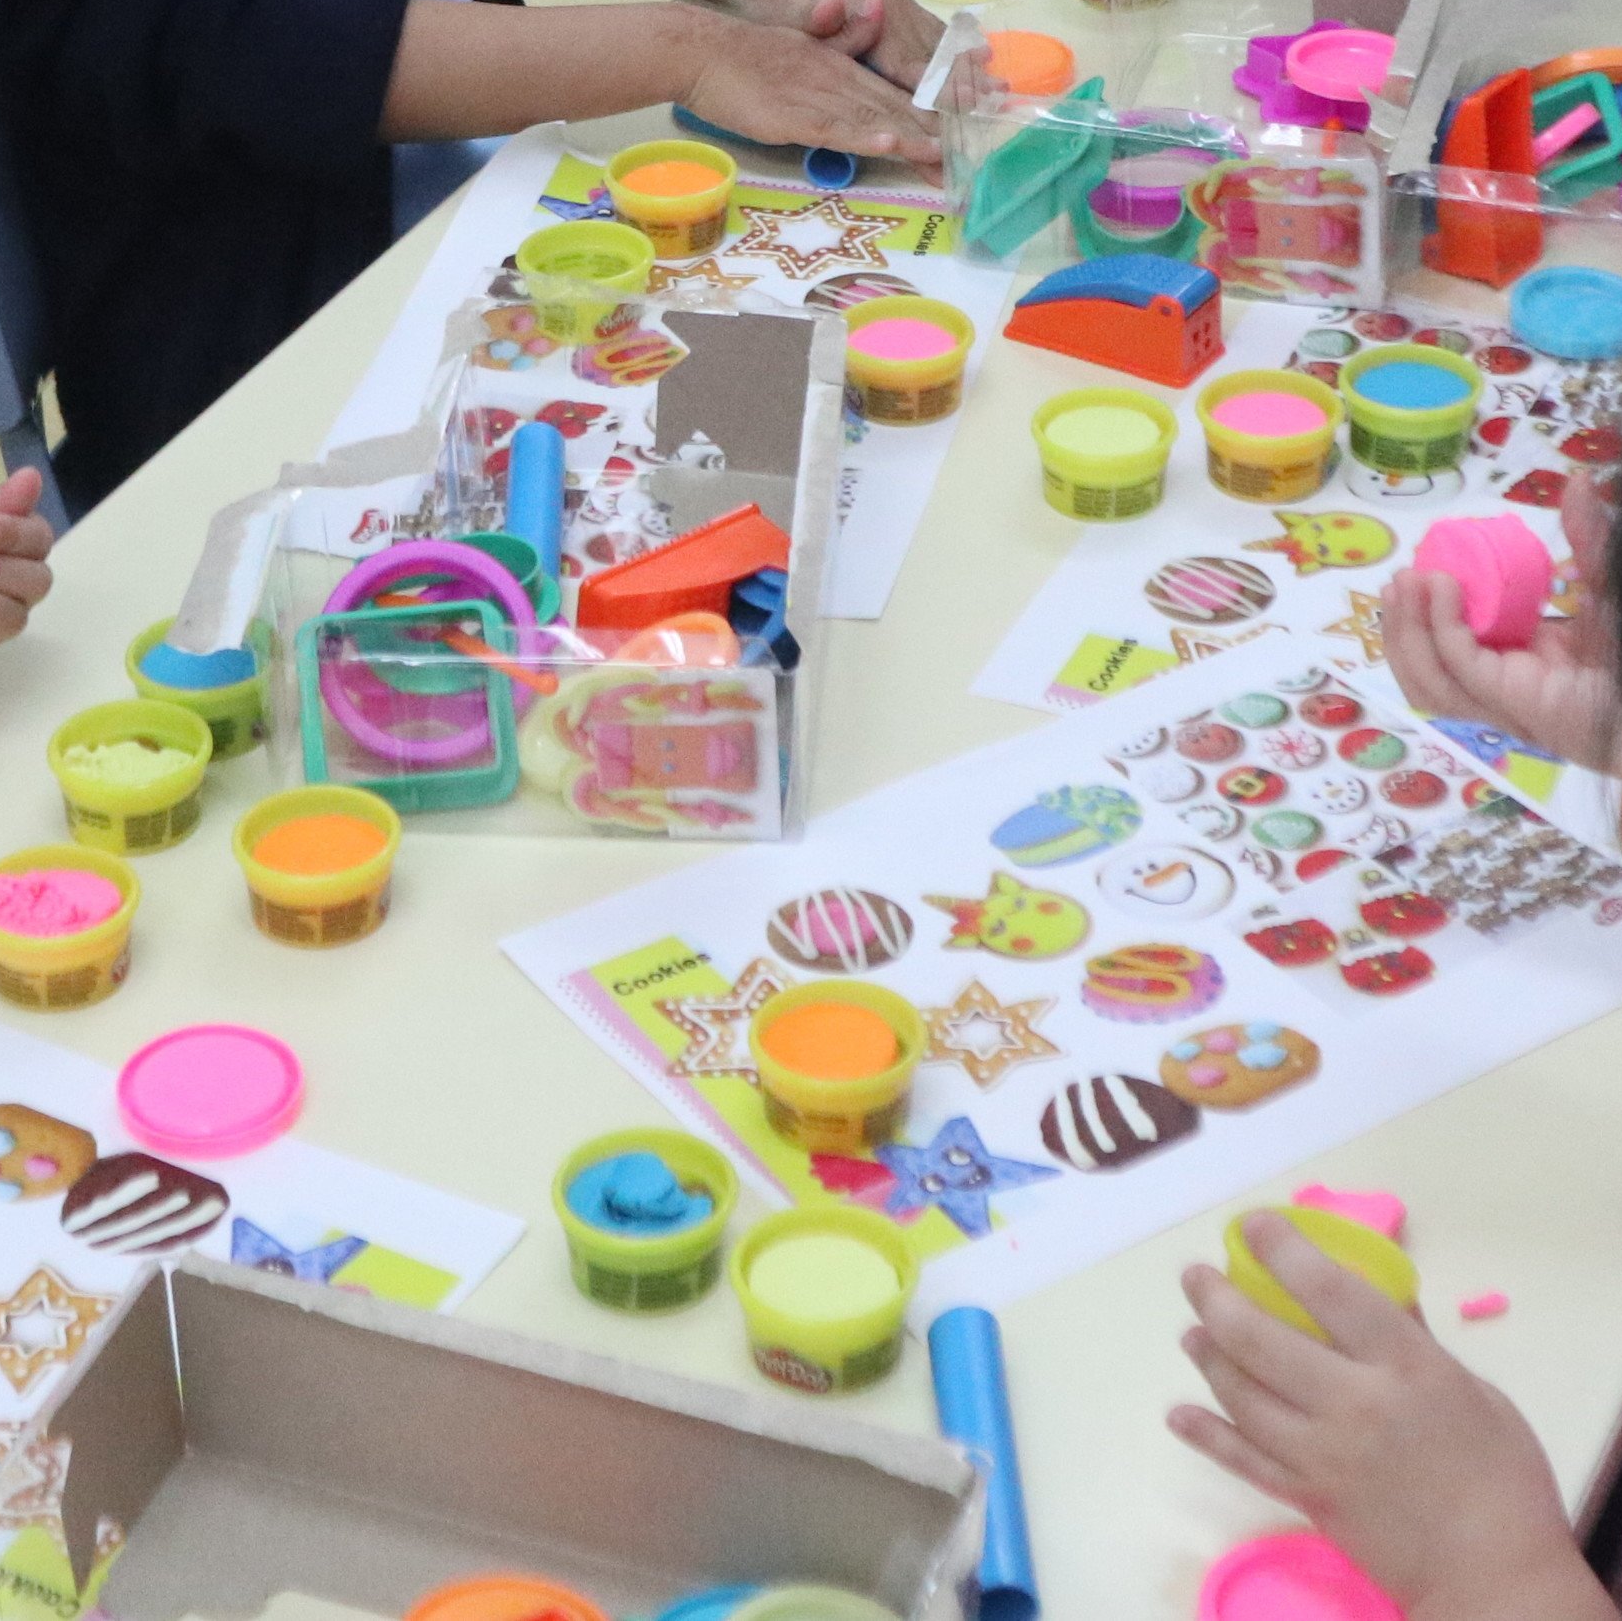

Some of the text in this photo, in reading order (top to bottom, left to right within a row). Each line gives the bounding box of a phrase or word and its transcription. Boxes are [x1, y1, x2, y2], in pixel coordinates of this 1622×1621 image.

[914, 213, 945, 258] Cookies
[1088, 635, 1137, 694] Cookies
[612, 949, 712, 998] Cookies
